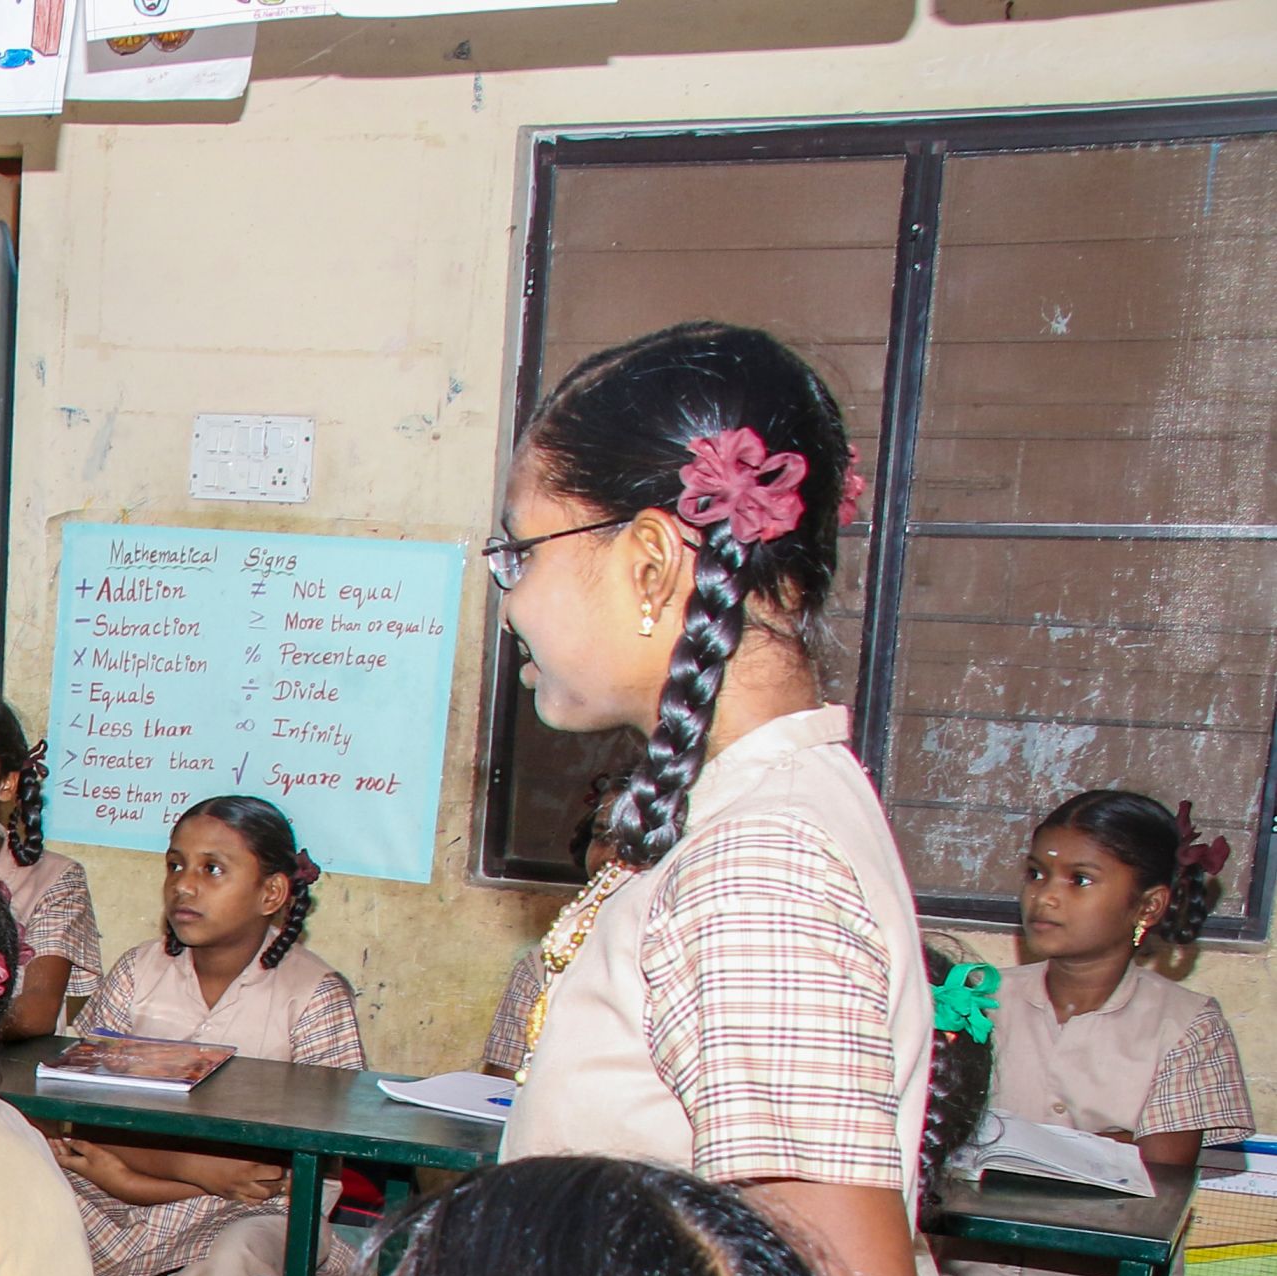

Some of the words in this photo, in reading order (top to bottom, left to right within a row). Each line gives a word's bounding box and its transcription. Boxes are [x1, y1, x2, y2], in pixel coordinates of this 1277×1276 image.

[110, 540, 218, 566] Mathematical
[244, 547, 297, 577] Signs
[96, 576, 187, 602] Addition
[339, 580, 402, 608] equal
[93, 613, 201, 638] Subraction
[285, 612, 323, 631] More
[331, 613, 361, 632] than
[368, 621, 384, 633] or
[386, 615, 425, 639] equal
[429, 617, 444, 635] to
[93, 648, 207, 678] Multiplication
[279, 642, 387, 668] Percentage
[90, 682, 155, 715] Equals
[273, 680, 339, 702] Divide
[87, 719, 134, 738] Less
[144, 721, 193, 738] than
[272, 718, 352, 756] Infinity
[83, 749, 155, 769] Greater
[170, 752, 215, 770] than
[264, 763, 341, 797] Square
[356, 772, 402, 795] root
[83, 783, 120, 801] Less
[127, 785, 162, 803] than
[171, 791, 191, 805] or
[95, 804, 144, 825] equal
